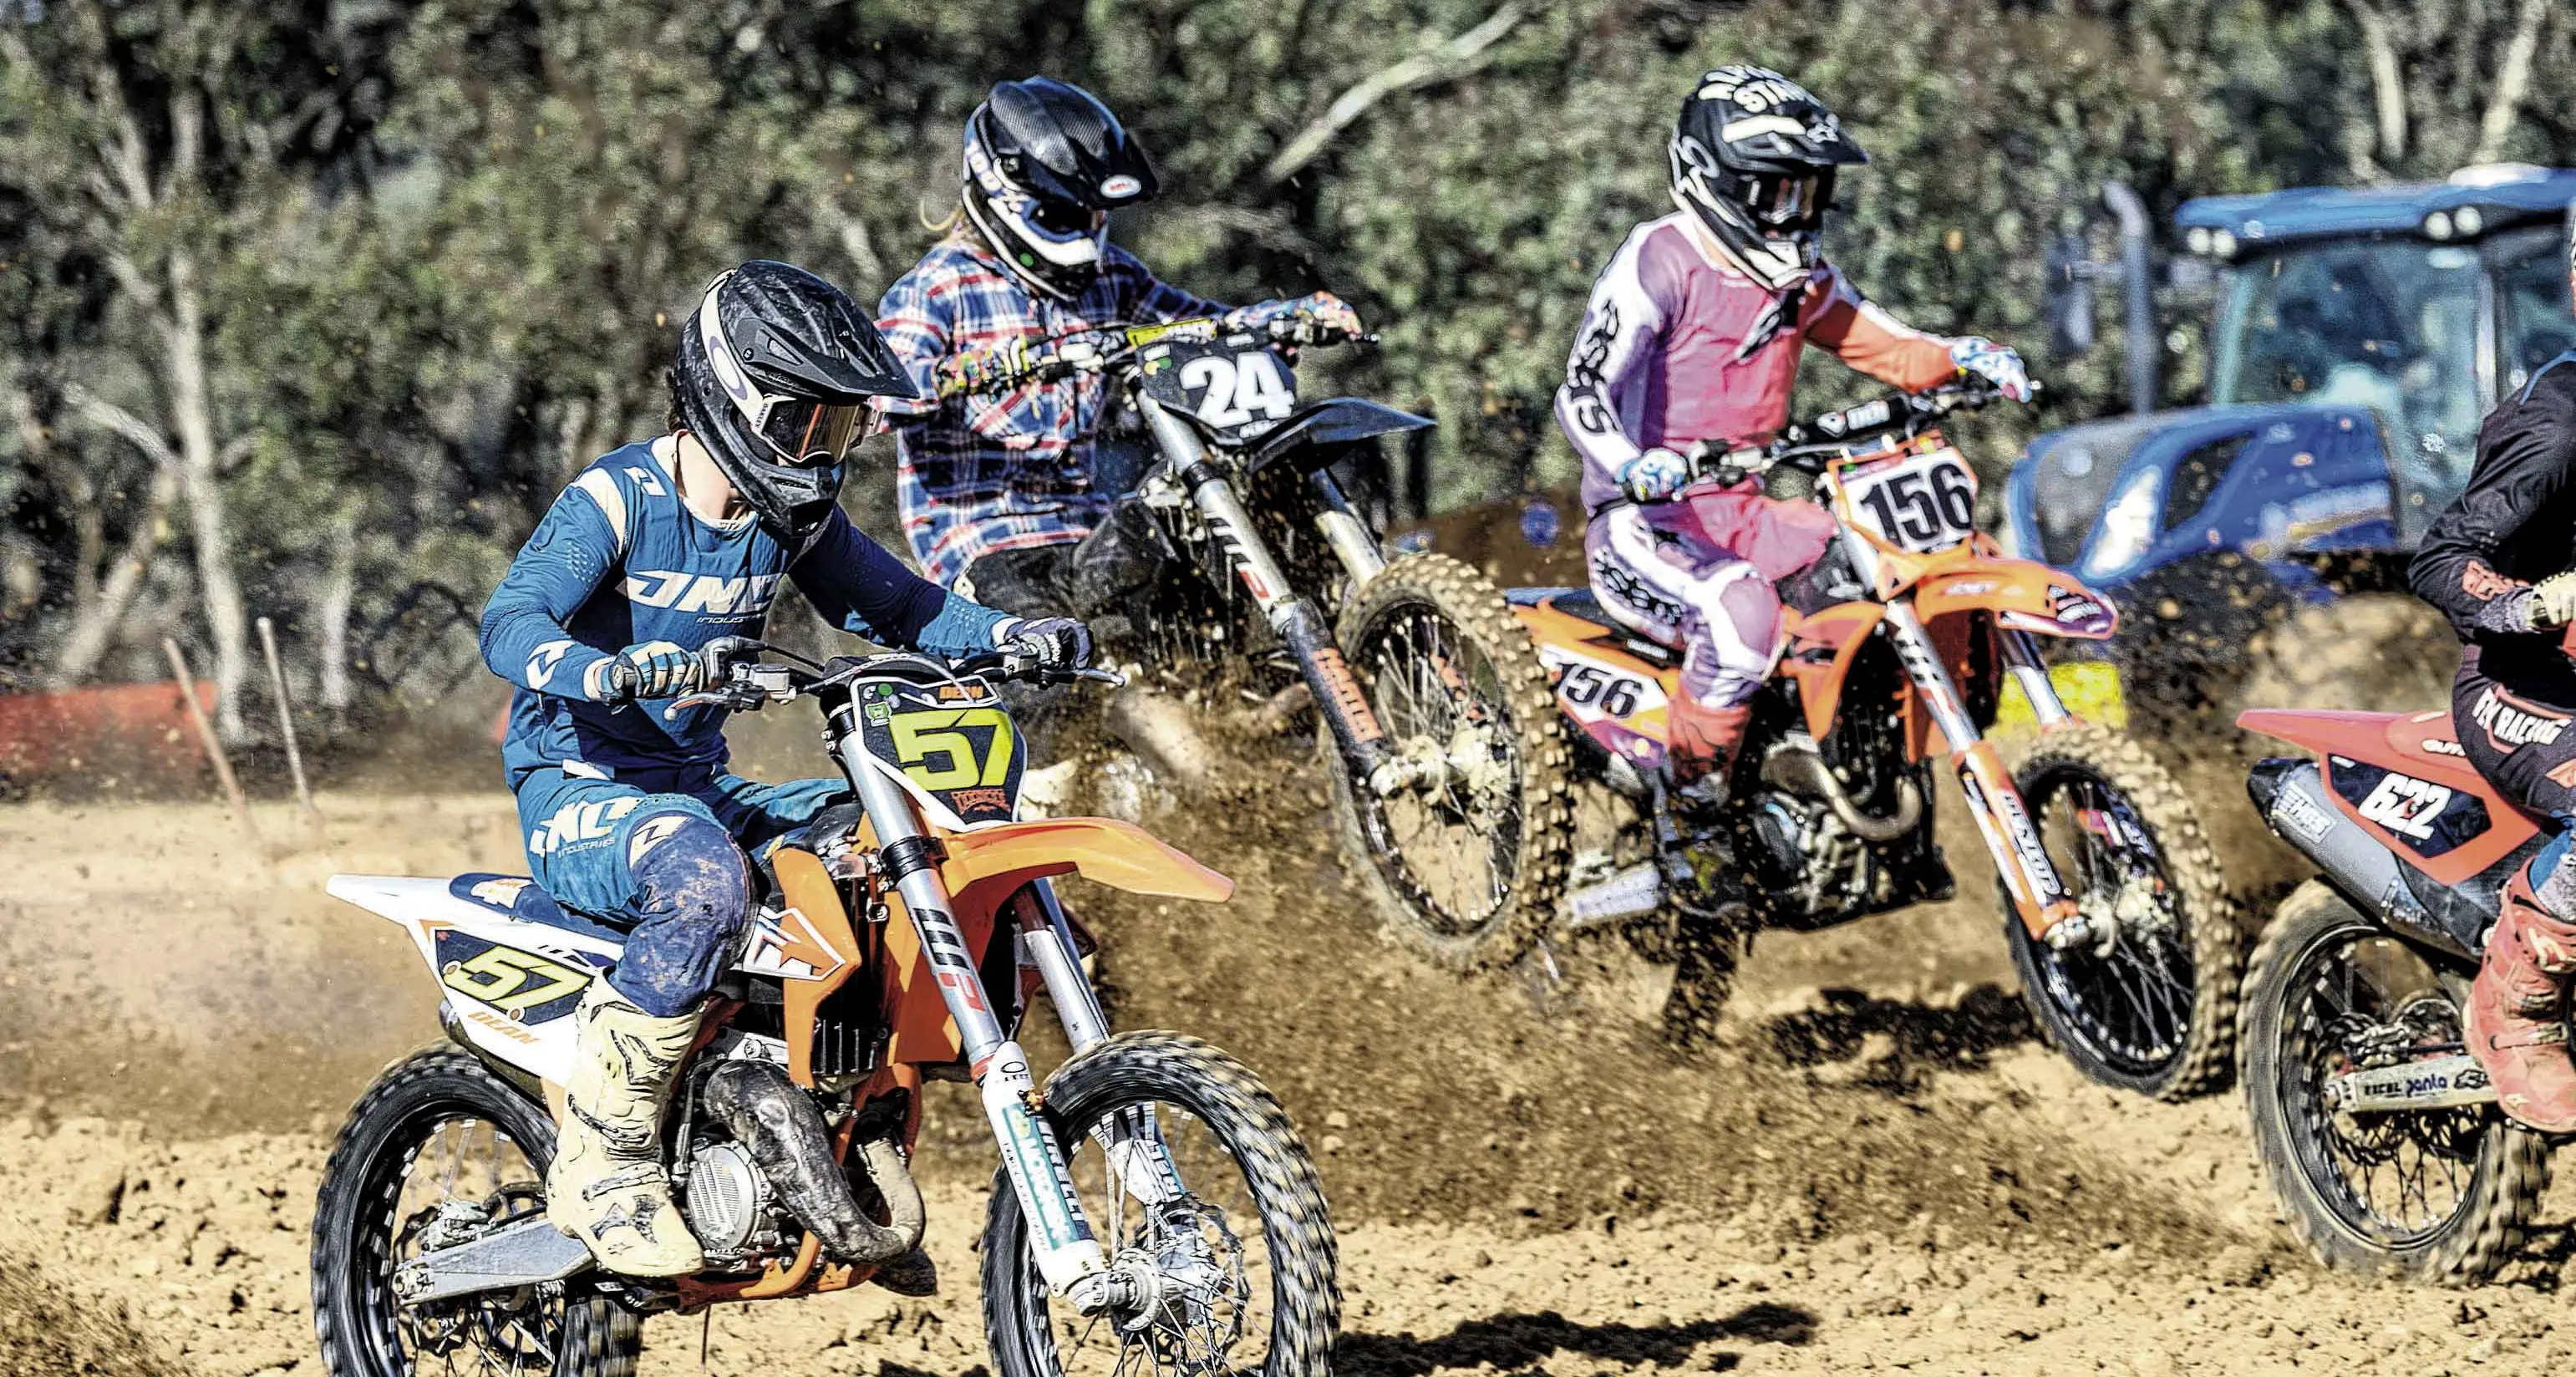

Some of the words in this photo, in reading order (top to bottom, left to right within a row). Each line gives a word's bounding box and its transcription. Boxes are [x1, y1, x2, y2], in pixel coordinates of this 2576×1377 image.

[1179, 351, 1295, 429] 24
[1860, 463, 1973, 548] 156
[1549, 662, 1644, 718] 156
[889, 708, 1014, 791] 57
[443, 945, 592, 1011] 57
[468, 1011, 542, 1044] DEAN
